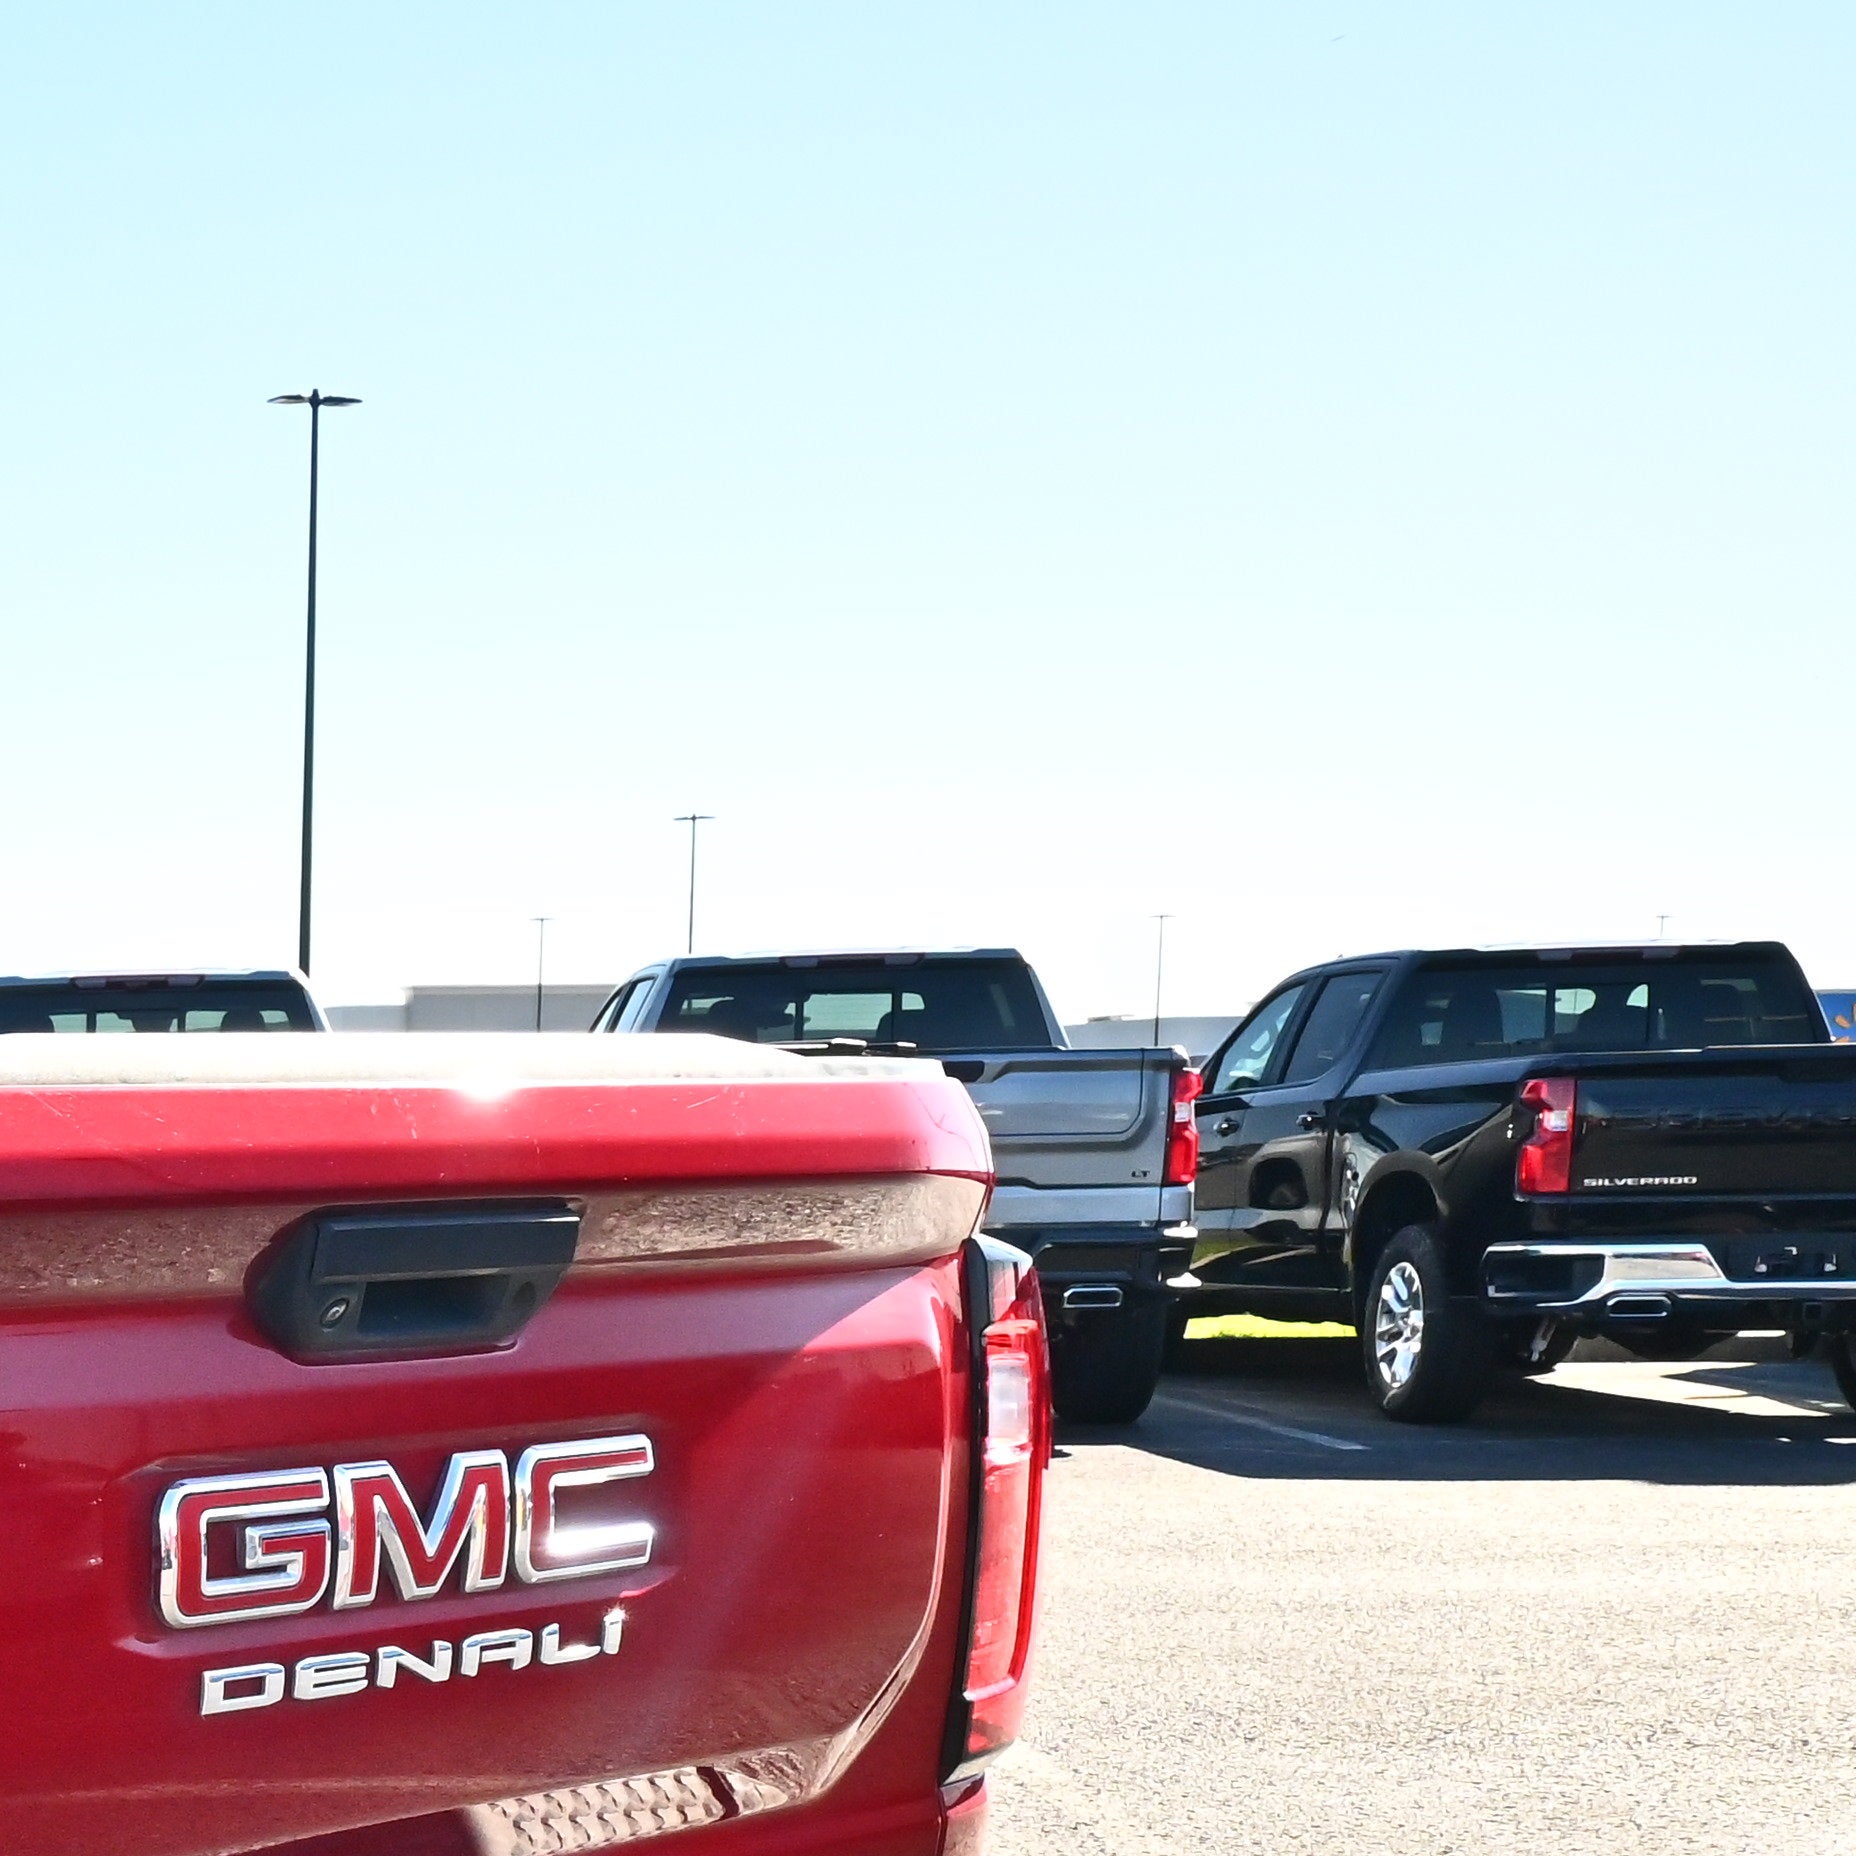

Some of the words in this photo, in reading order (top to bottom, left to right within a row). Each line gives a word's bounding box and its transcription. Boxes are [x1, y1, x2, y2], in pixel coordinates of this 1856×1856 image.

[1583, 1176, 1697, 1187] SILVERADO
[160, 1433, 655, 1629] GMC
[199, 1605, 624, 1716] DENALI
